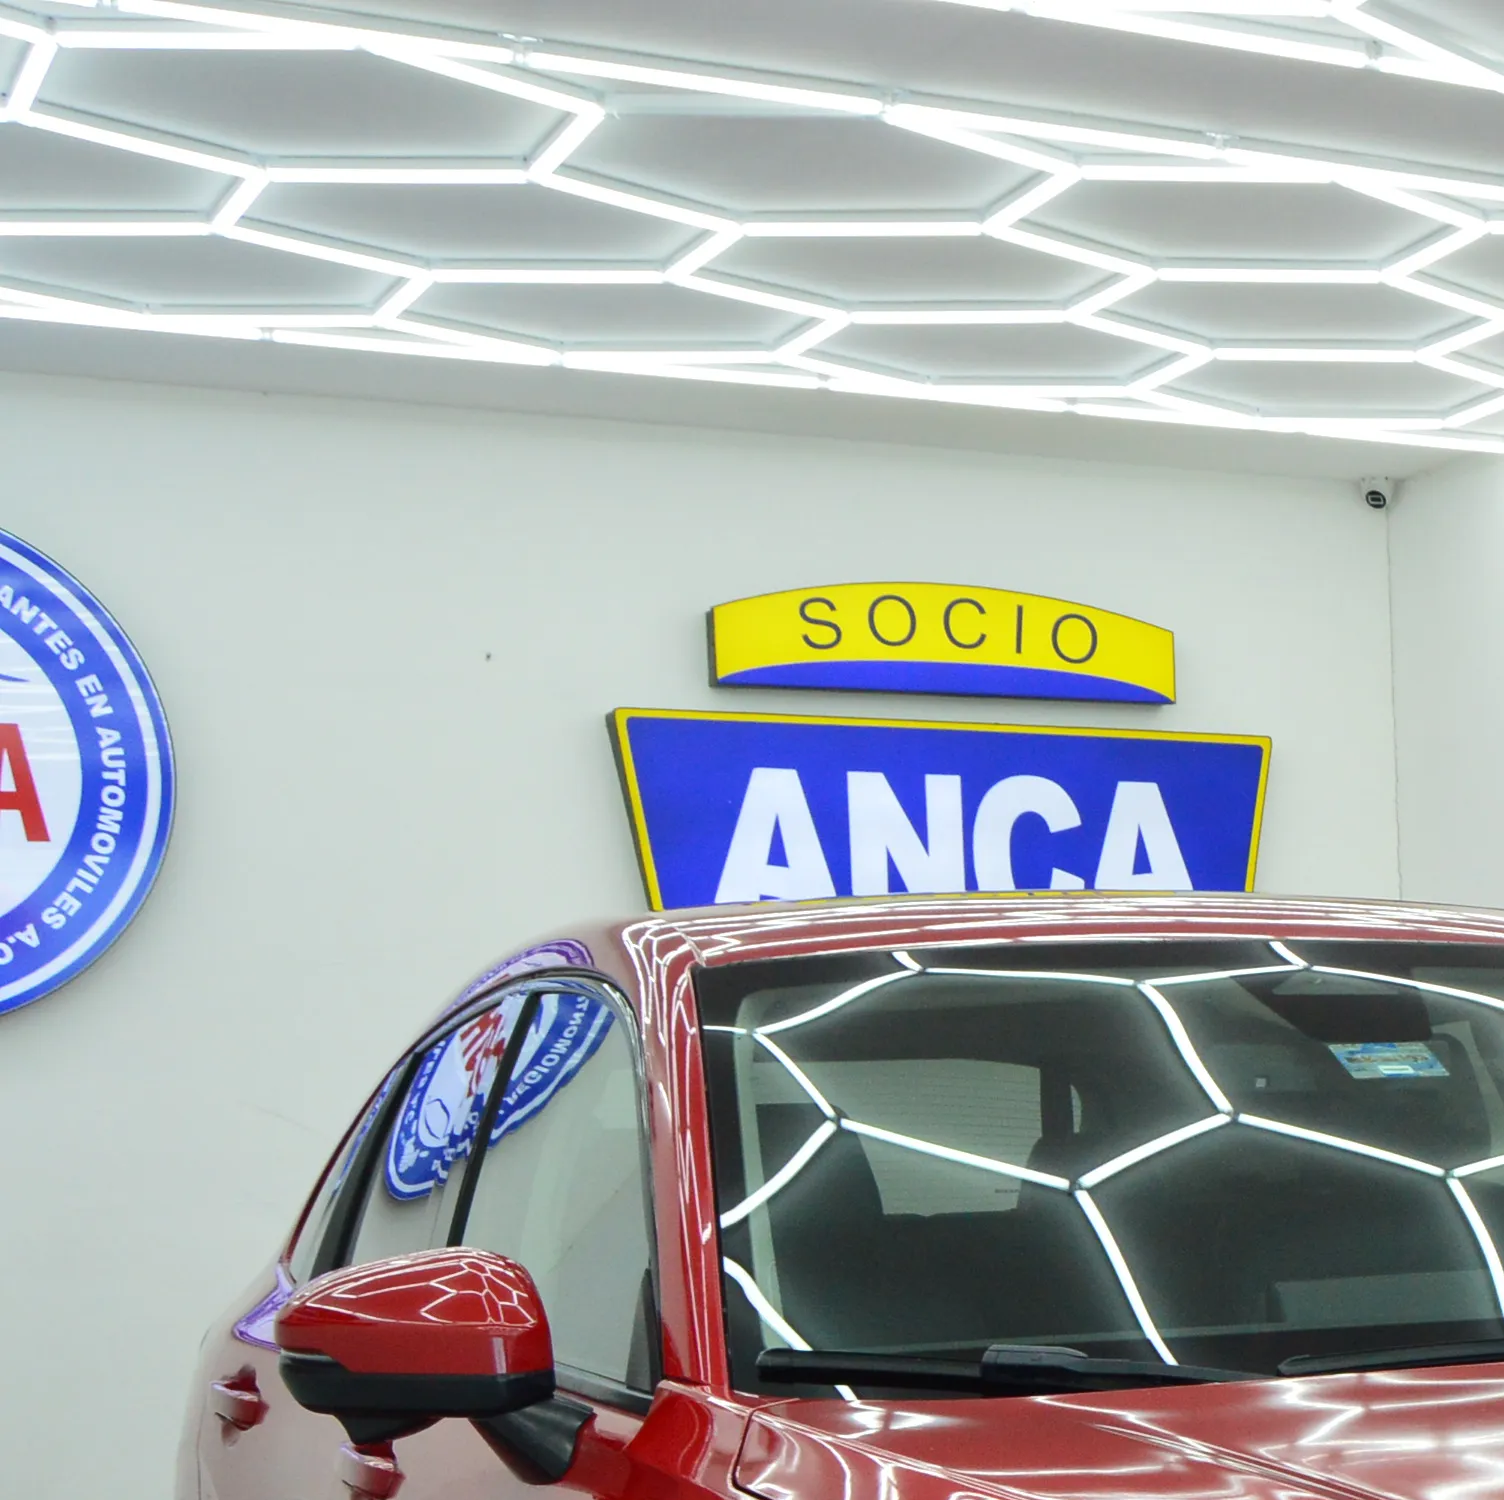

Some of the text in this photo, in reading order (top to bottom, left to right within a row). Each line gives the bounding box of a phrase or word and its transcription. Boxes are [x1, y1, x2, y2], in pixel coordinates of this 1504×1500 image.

[798, 595, 1098, 664] SOCIO
[75, 673, 114, 718] EN
[41, 726, 126, 930] AUTOMOVILES
[714, 767, 1194, 904] ANCA
